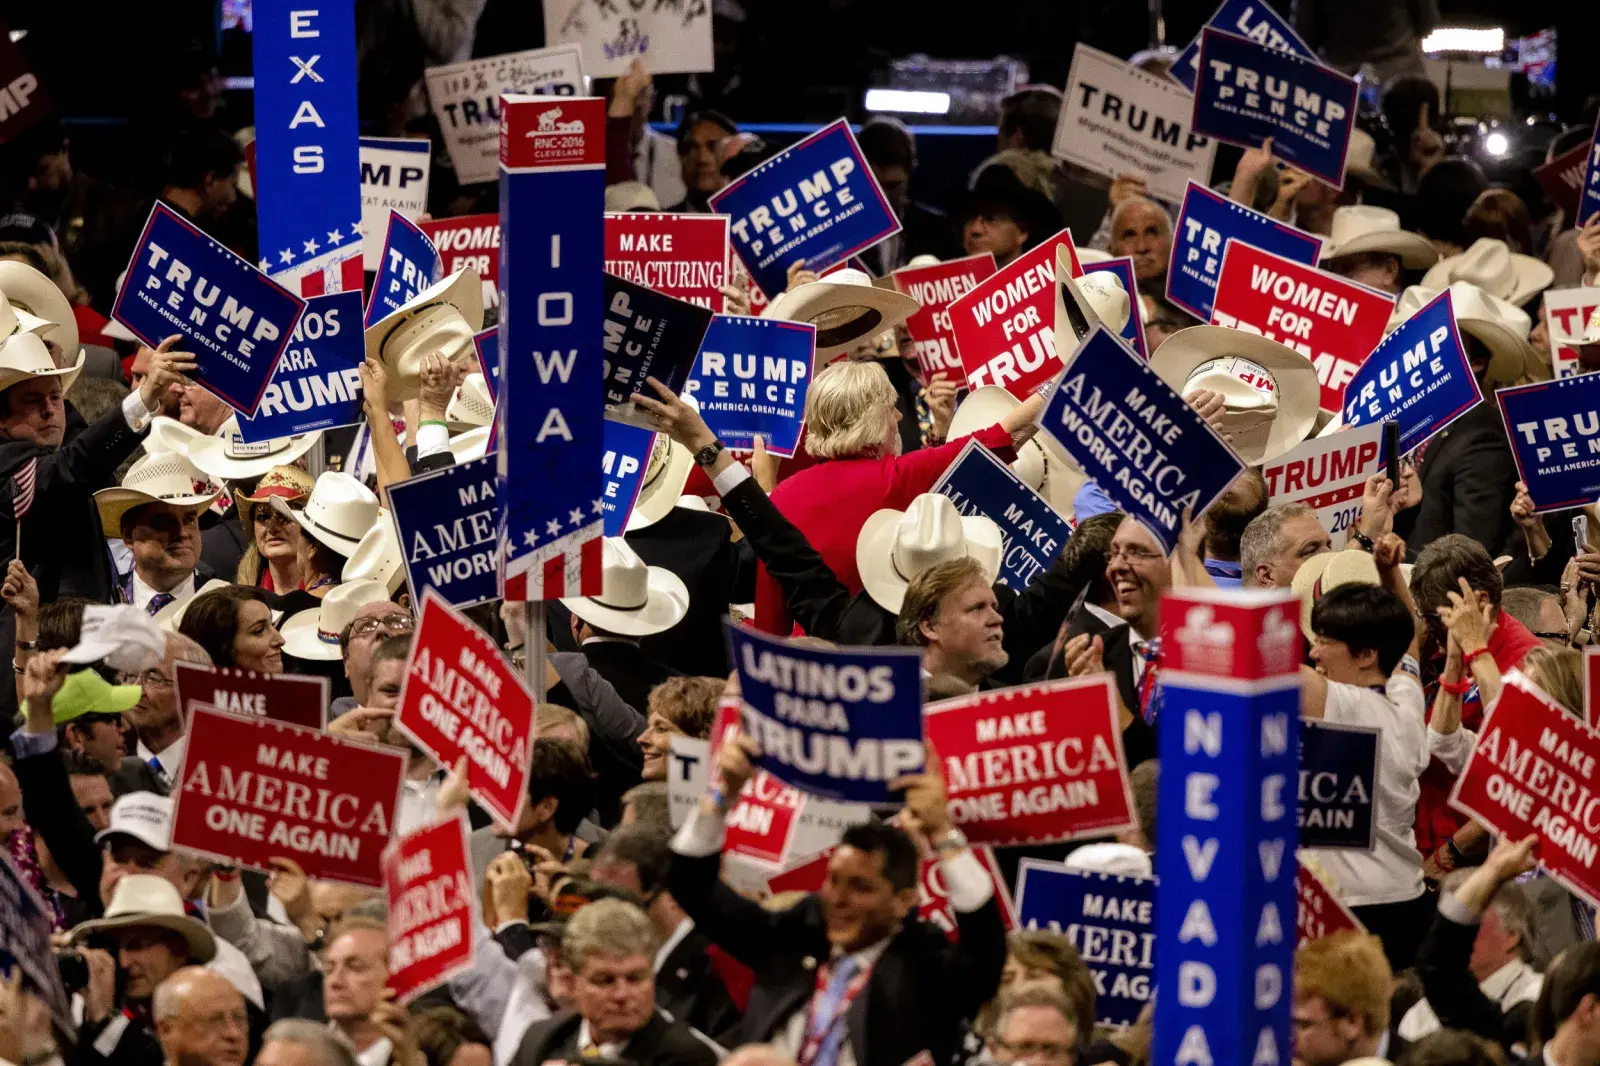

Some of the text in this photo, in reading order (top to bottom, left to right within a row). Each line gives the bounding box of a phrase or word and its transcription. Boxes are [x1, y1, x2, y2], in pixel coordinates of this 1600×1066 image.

[1079, 82, 1208, 152] TRUMP
[1209, 59, 1346, 122] TRUMP
[1219, 85, 1331, 138] PENCE
[534, 149, 586, 159] CLEVELAND
[382, 198, 423, 210] AGAIN!
[731, 156, 855, 244] TRUMP
[751, 187, 855, 257] PENCE
[620, 234, 673, 253] MAKE
[774, 236, 807, 260] AMERICA
[807, 219, 834, 239] GREAT
[834, 201, 865, 224] AGAIN!
[148, 242, 280, 342] TRUMP
[452, 255, 490, 278] FOR
[604, 259, 724, 289] UFACTURING
[908, 272, 978, 308] WOMEN
[971, 258, 1056, 328] WOMEN
[1251, 264, 1359, 328] WOMEN
[137, 289, 251, 374] MAKE AMERICA GREAT AGAIN!
[145, 274, 256, 358] PENCE
[532, 233, 578, 443] IOWA
[1002, 305, 1042, 342] FOR
[1267, 306, 1313, 341] FOR
[604, 314, 653, 413] PENCE
[639, 348, 656, 378] GREAT
[650, 318, 668, 350] AGAIN!
[1346, 325, 1449, 422] TRUMP
[686, 379, 796, 405] PENCE
[708, 401, 750, 413] AMERICA
[752, 404, 775, 415] GREAT
[776, 407, 795, 419] AGAIN!
[1125, 387, 1184, 446] MAKE
[1350, 356, 1445, 427] PENCE
[1377, 371, 1452, 425] ERICA GREAT AGAIN!
[1061, 372, 1202, 514] AMERICA
[1061, 404, 1178, 532] WORK AGAIN
[1265, 440, 1379, 498] TRUMP
[1538, 465, 1562, 476] MAKE
[1003, 503, 1058, 558] MAKE
[212, 688, 268, 716] MAKE
[458, 646, 503, 701] MAKE
[741, 642, 896, 704] LATINOS
[410, 646, 527, 775] AMERICA
[773, 691, 851, 733] PARA
[976, 710, 1047, 744] MAKE
[256, 743, 330, 780] MAKE
[419, 693, 512, 790] ONE AGAIN
[740, 702, 926, 782] TRUMP
[1538, 726, 1596, 779] MAKE
[184, 760, 389, 837] AMERICA
[945, 778, 1099, 825] ONE AGAIN
[1485, 773, 1598, 869] ONE AGAIN
[205, 804, 266, 842] ONE
[268, 822, 361, 862] AGAIN
[1082, 893, 1153, 925] MAKE
[1174, 708, 1223, 1066] NEVADA
[1252, 711, 1289, 1066] NEVADA
